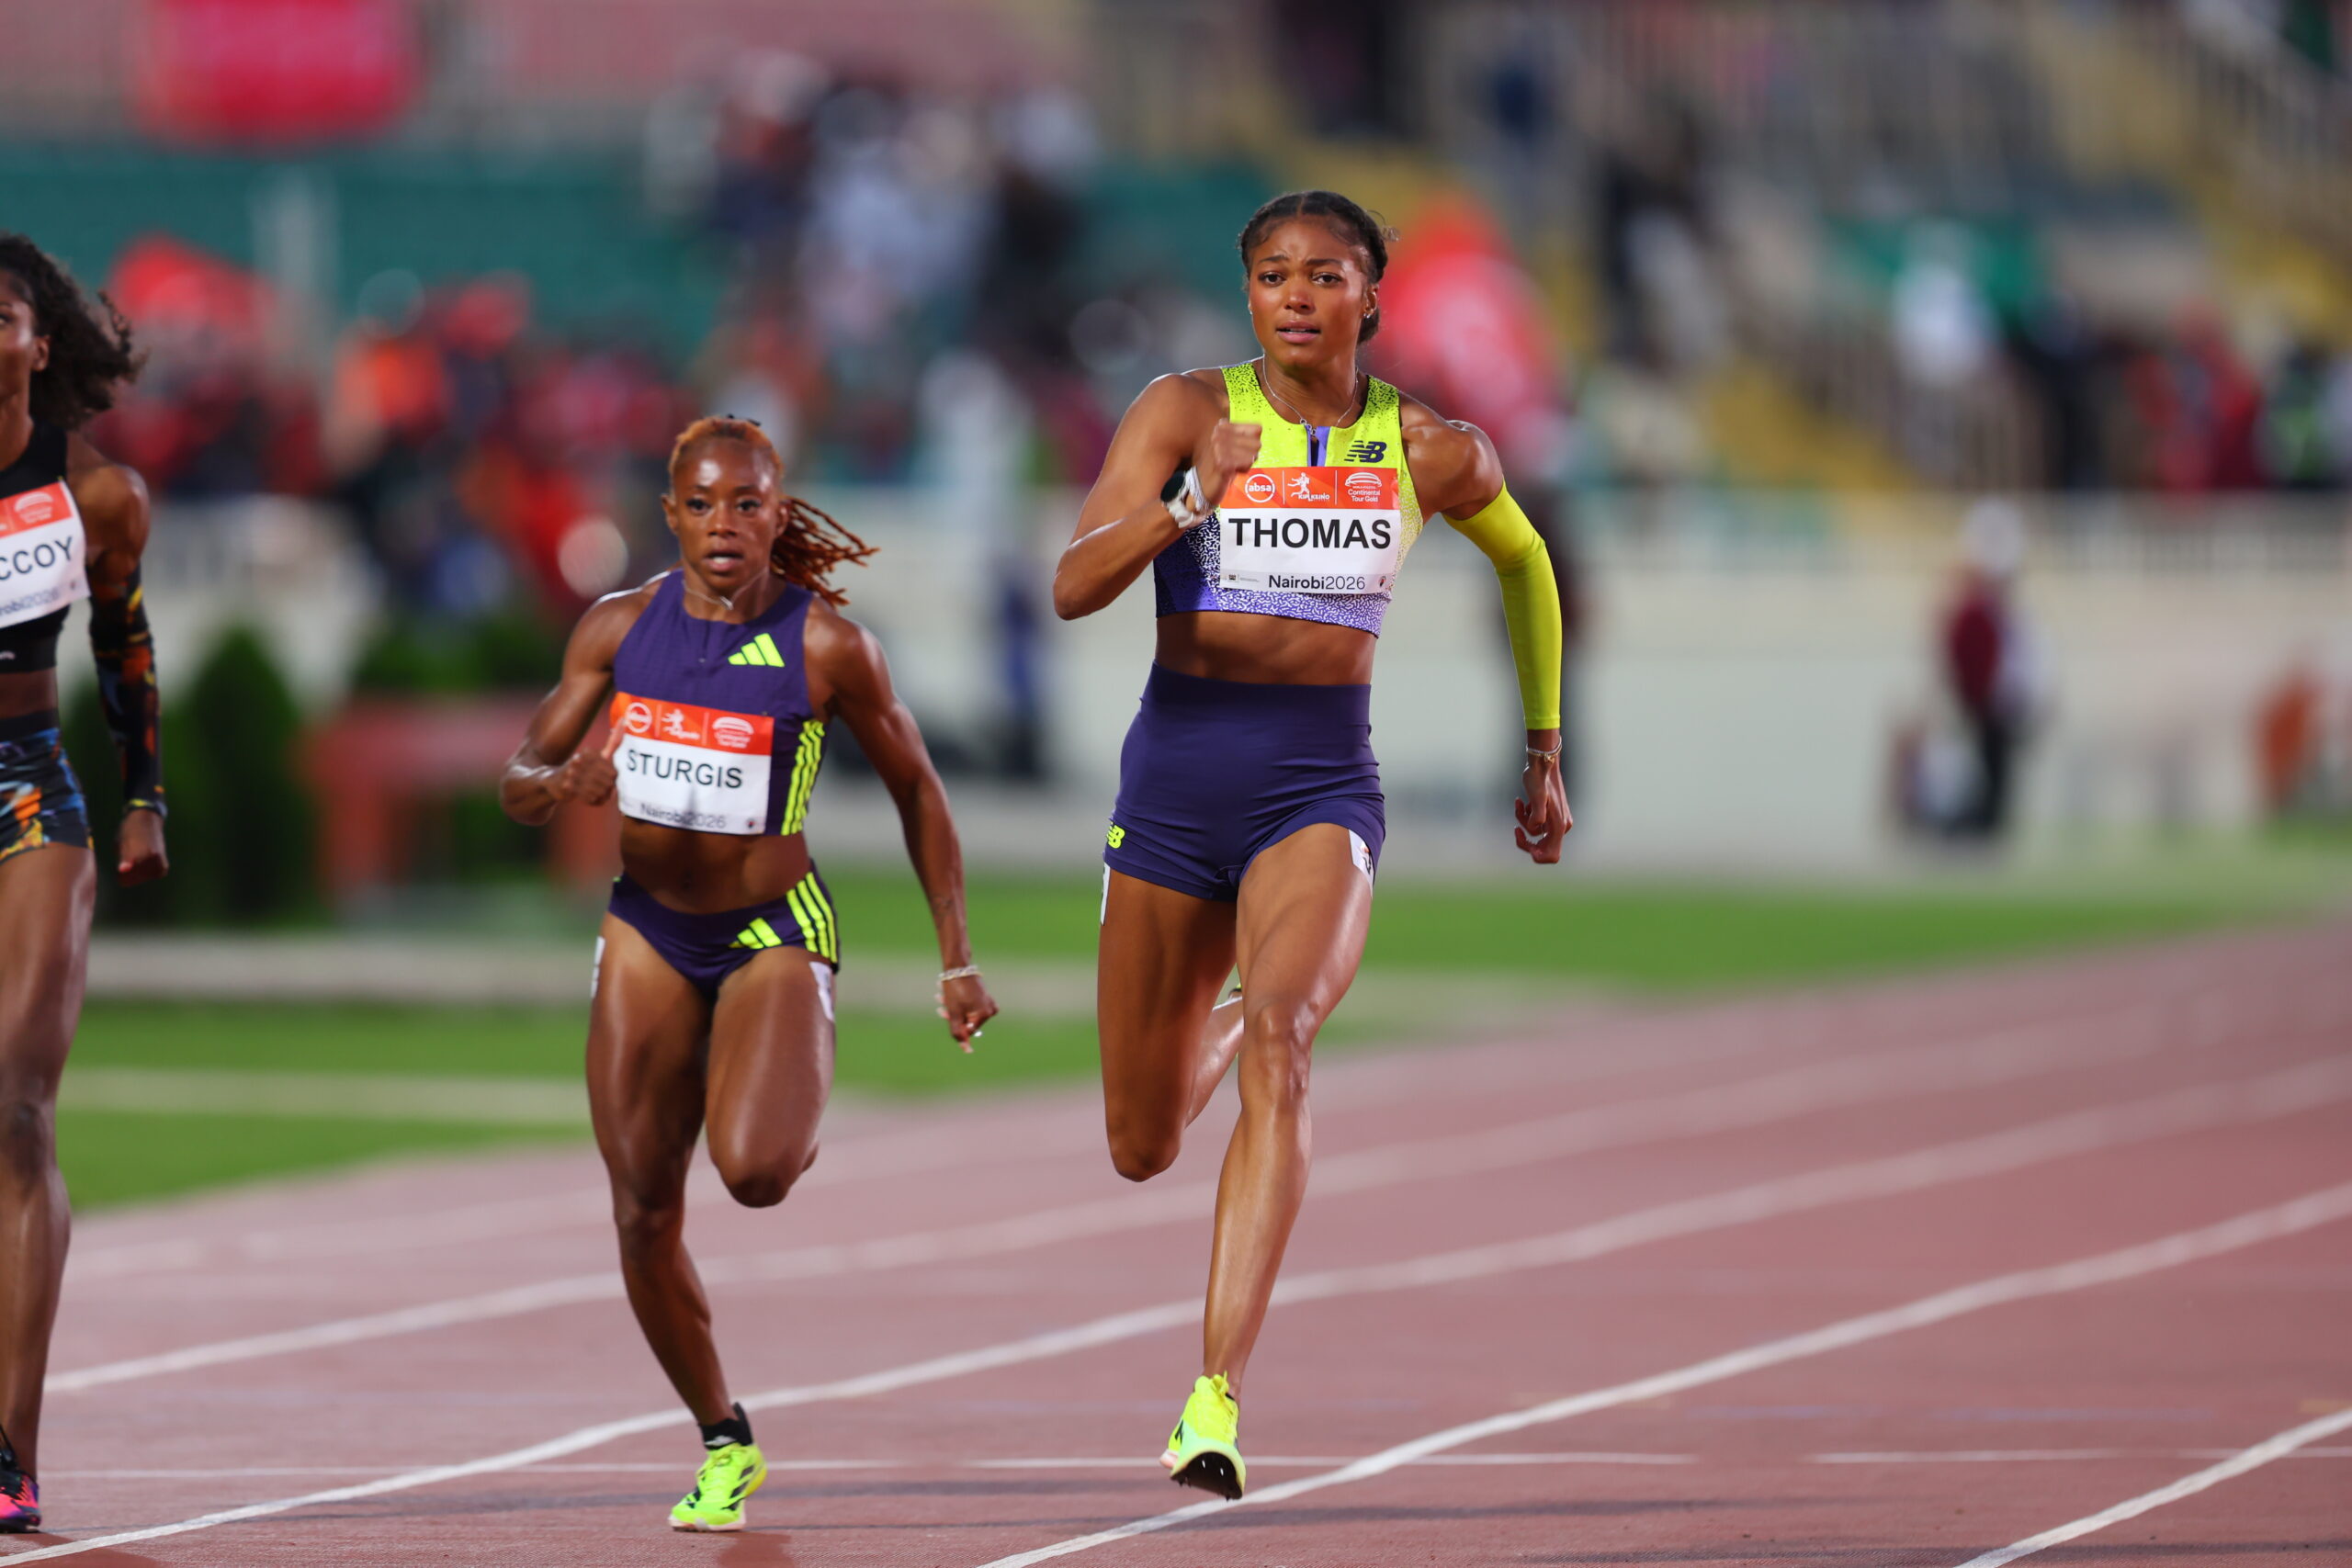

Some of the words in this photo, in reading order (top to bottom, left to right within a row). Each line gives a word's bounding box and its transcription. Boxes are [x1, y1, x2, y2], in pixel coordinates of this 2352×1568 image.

[1344, 440, 1387, 463] NB
[1249, 482, 1272, 492] absa
[1227, 517, 1392, 549] THOMAS
[0, 536, 73, 581] CCOY
[1268, 574, 1366, 590] Nairobi2026
[626, 749, 743, 789] STURGIS
